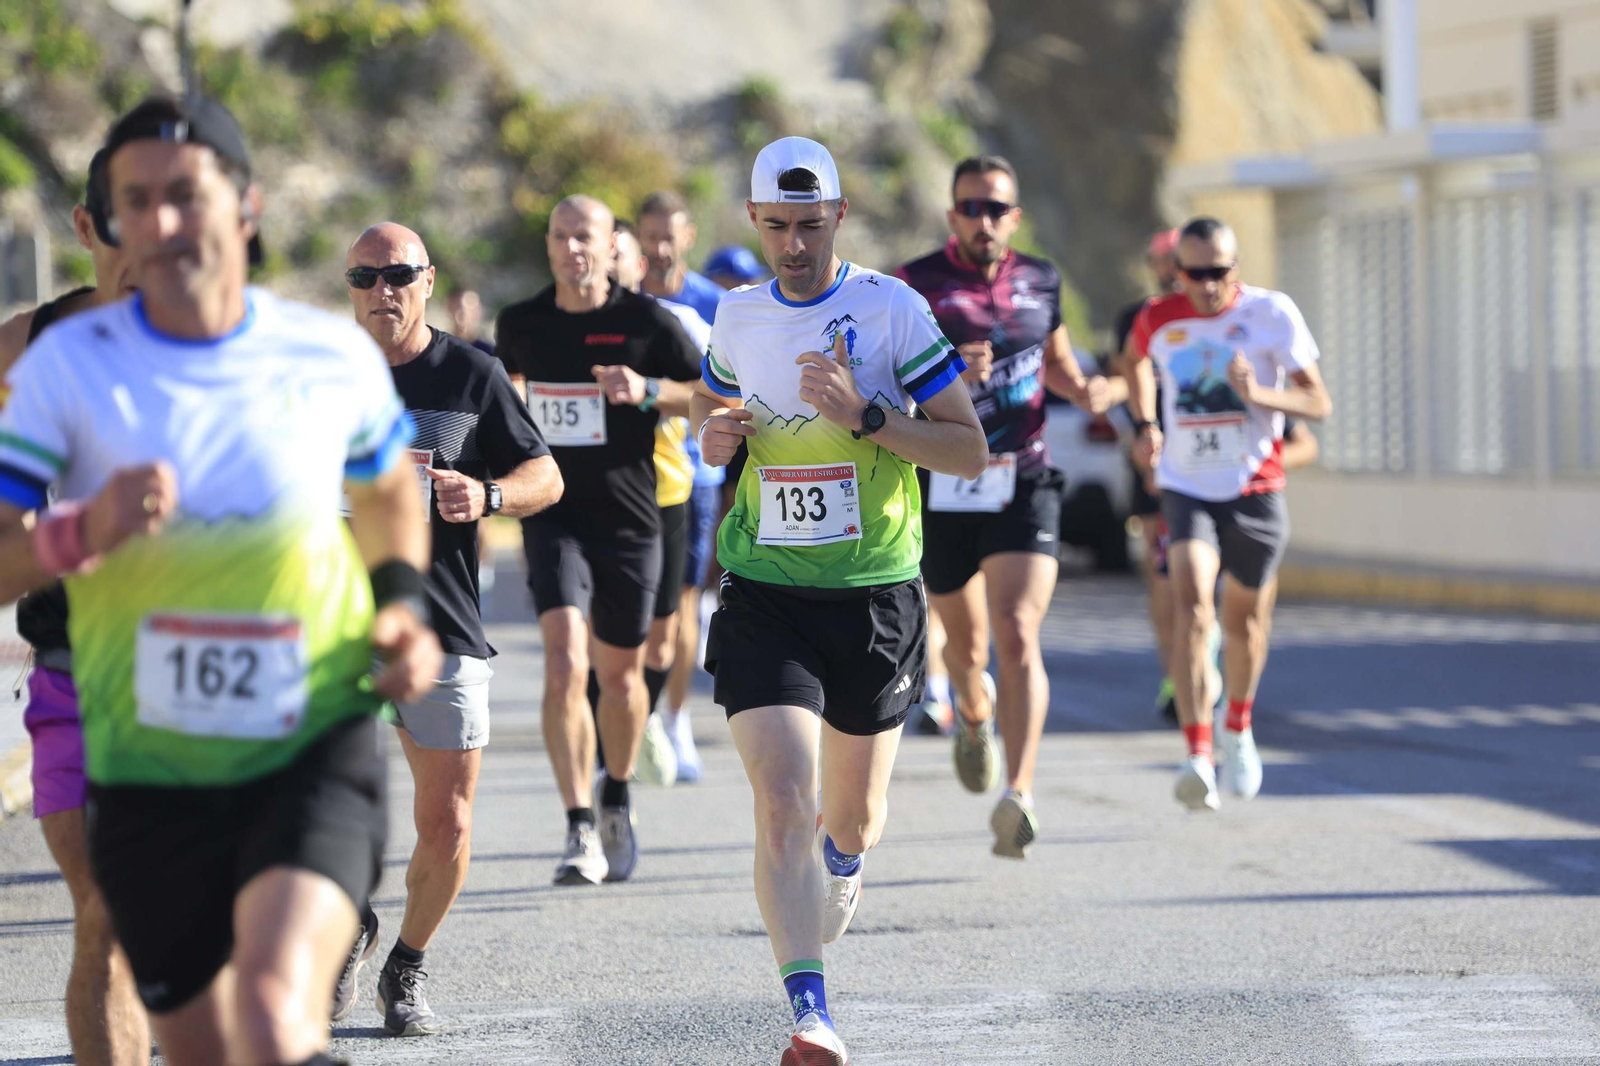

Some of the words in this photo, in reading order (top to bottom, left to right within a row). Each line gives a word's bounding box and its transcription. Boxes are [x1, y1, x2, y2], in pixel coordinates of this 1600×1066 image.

[539, 399, 579, 426] 135
[800, 470, 813, 478] DEL
[814, 468, 852, 477] ESTRECHO
[776, 487, 827, 522] 133
[164, 644, 258, 699] 162
